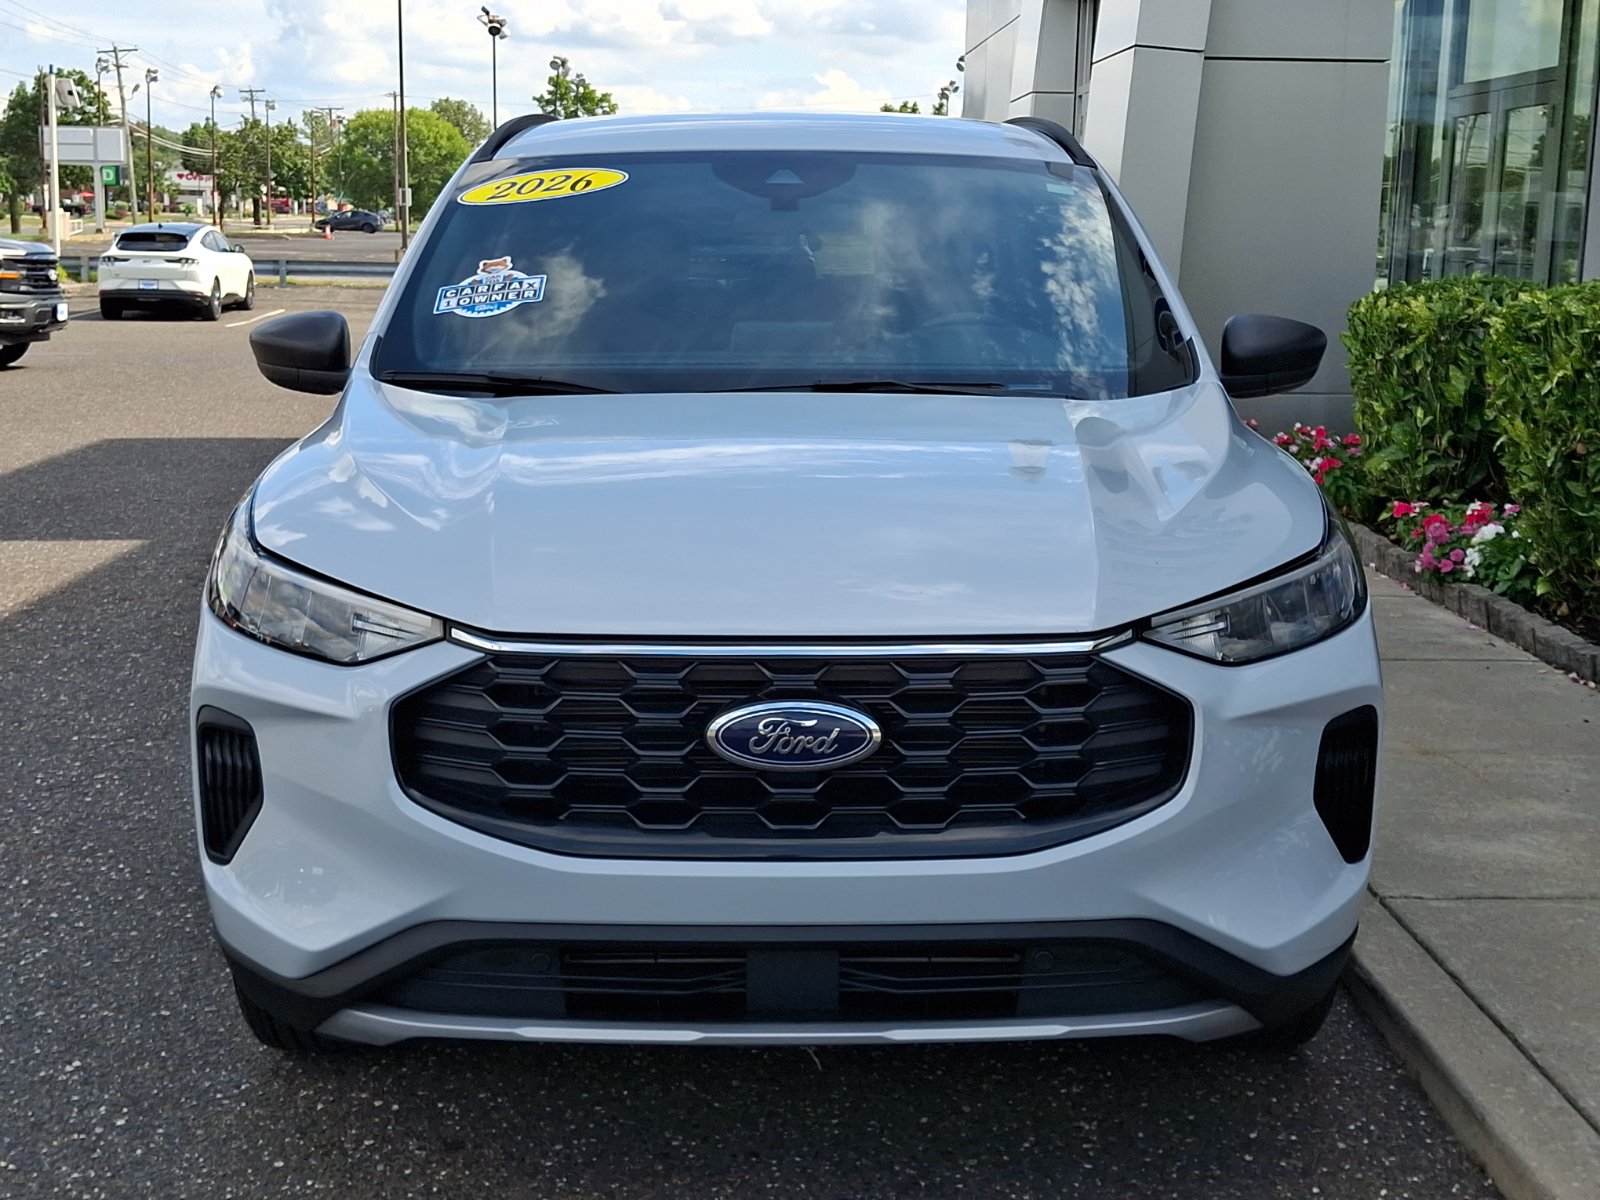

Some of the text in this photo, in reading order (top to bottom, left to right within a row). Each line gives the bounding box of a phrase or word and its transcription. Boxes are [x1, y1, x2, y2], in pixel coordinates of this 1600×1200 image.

[102, 169, 114, 181] D
[186, 173, 204, 181] CVS
[486, 173, 597, 200] 2026
[445, 281, 536, 297] CARFAX
[459, 290, 535, 305] OWNER
[748, 717, 841, 754] Ford
